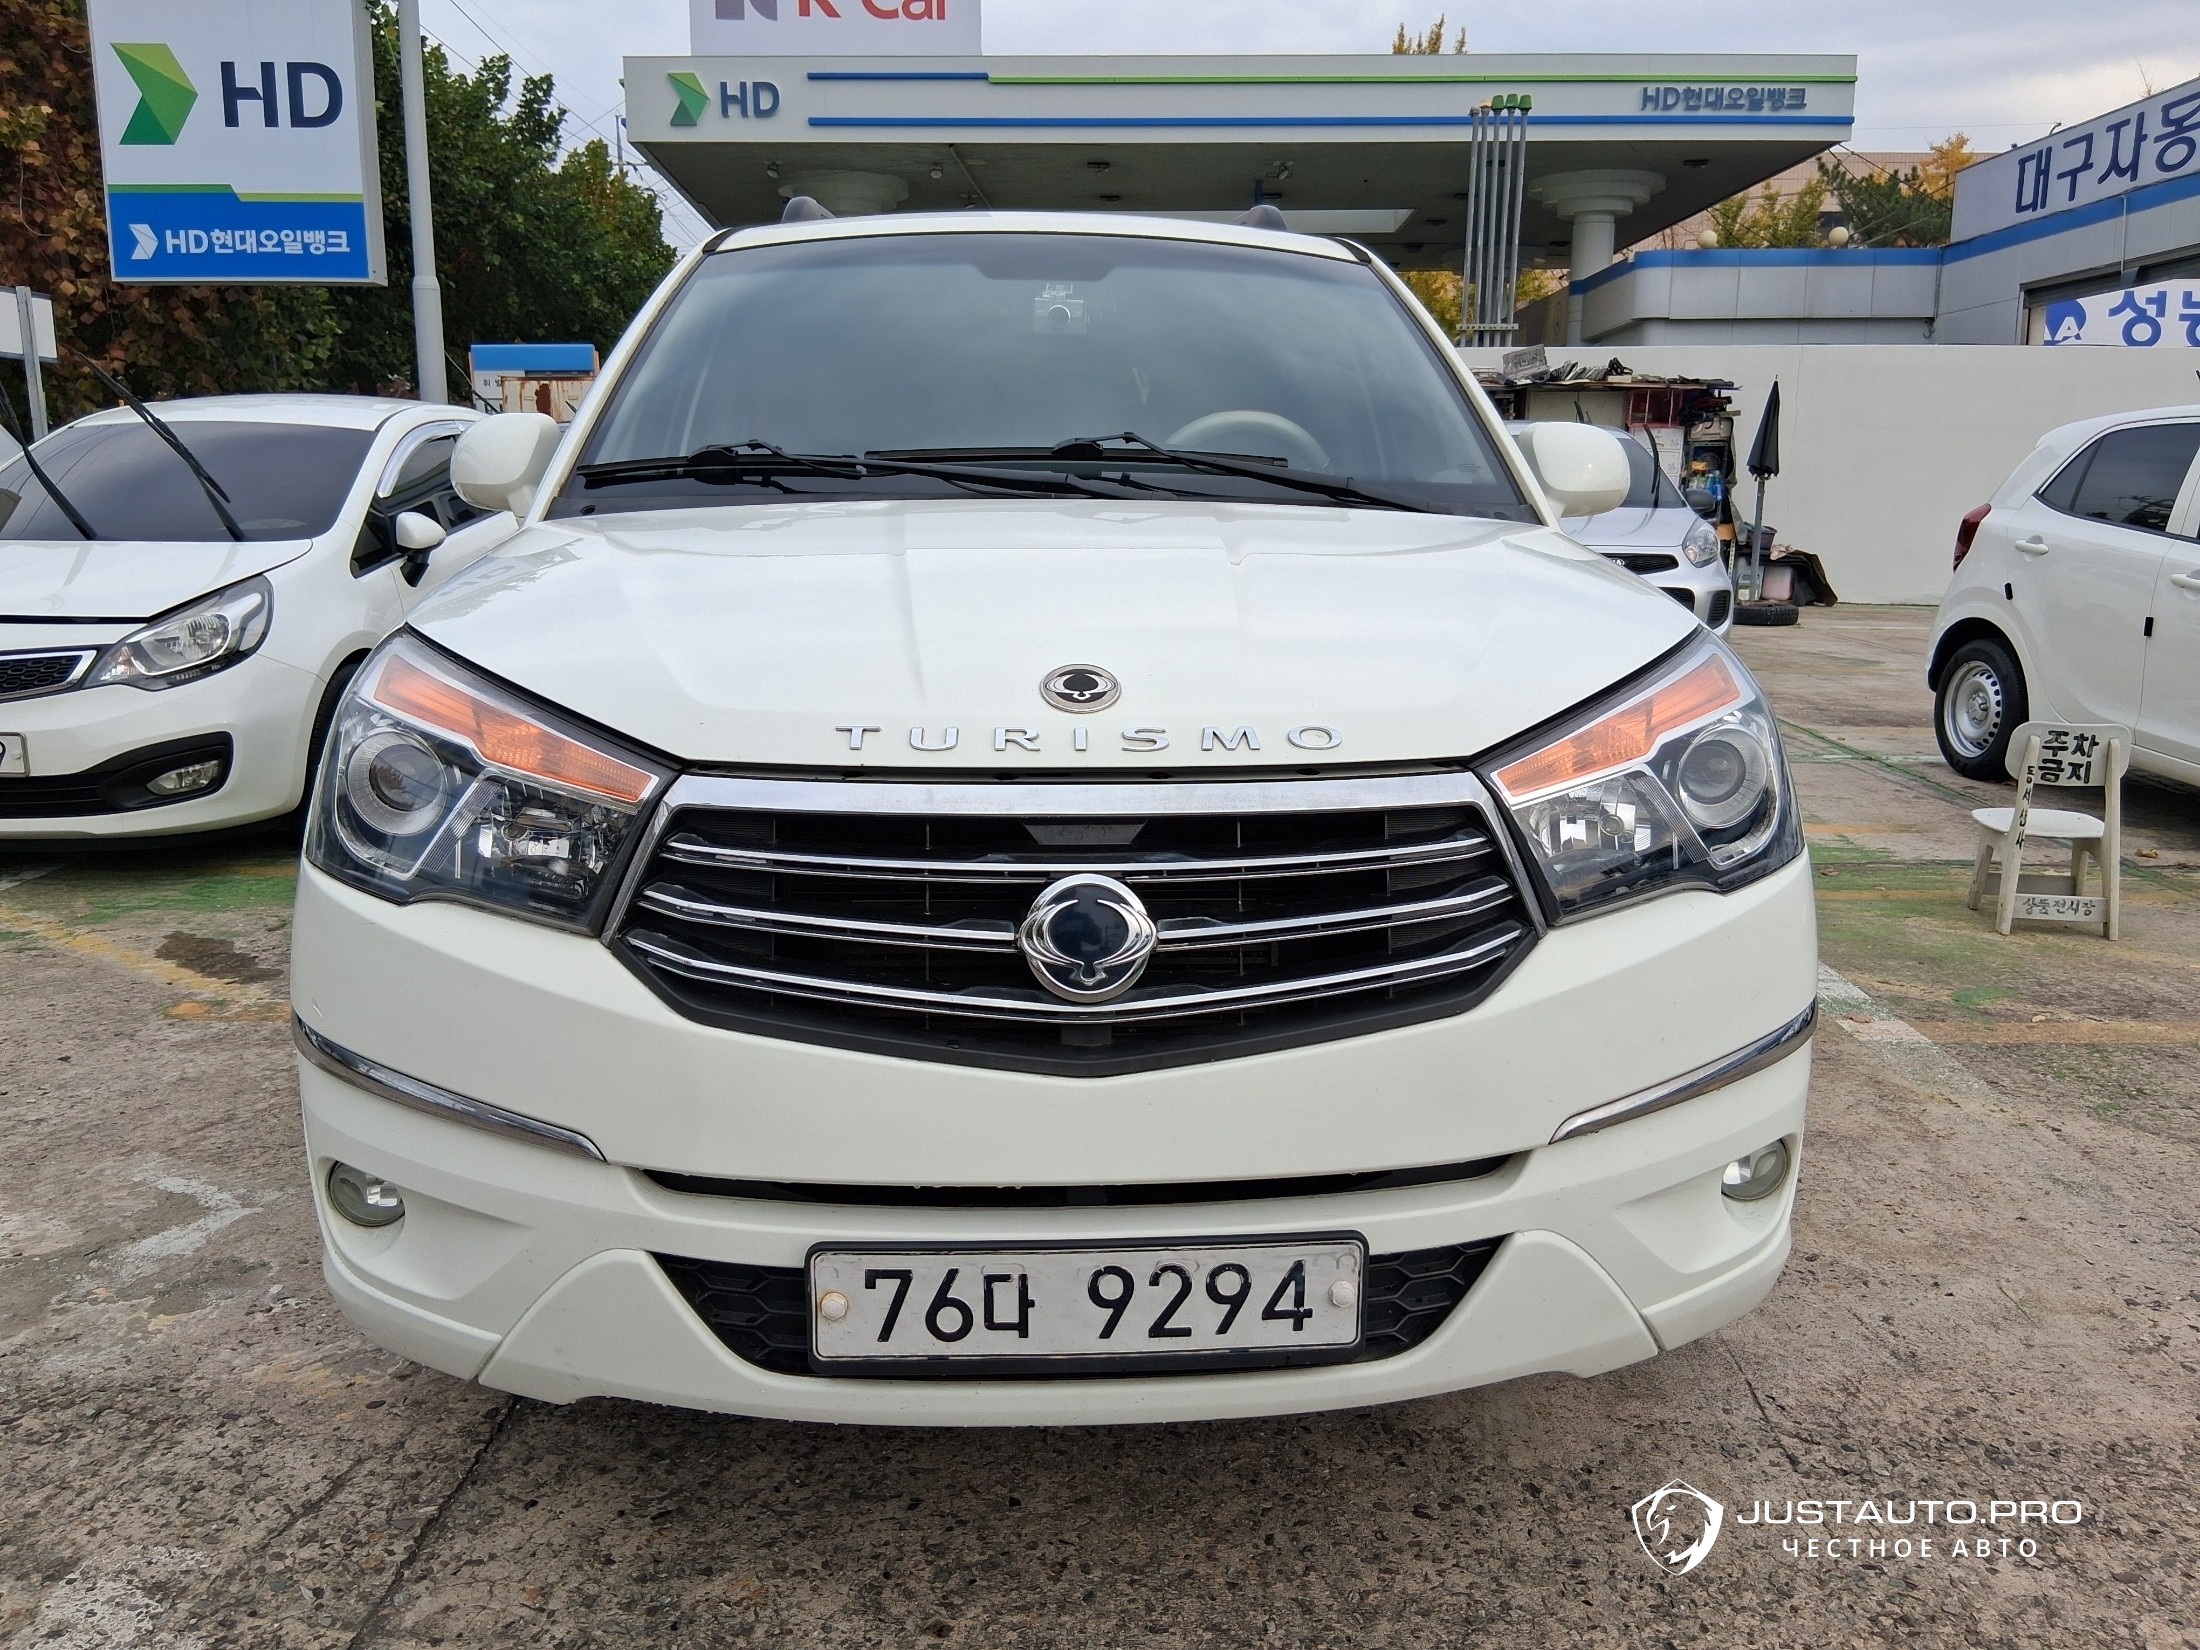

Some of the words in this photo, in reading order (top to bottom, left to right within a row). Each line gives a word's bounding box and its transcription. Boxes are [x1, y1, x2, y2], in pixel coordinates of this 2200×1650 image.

[220, 60, 344, 129] HD
[720, 81, 781, 118] HD
[1641, 86, 1807, 111] HD현대오일뱅크
[165, 228, 350, 255] HD현대오일뱅크
[836, 725, 1344, 751] TURISMO
[2042, 730, 2100, 758] 주차
[2038, 758, 2092, 784] 금지
[864, 1267, 1036, 1343] 76다
[1087, 1258, 1314, 1340] 9294
